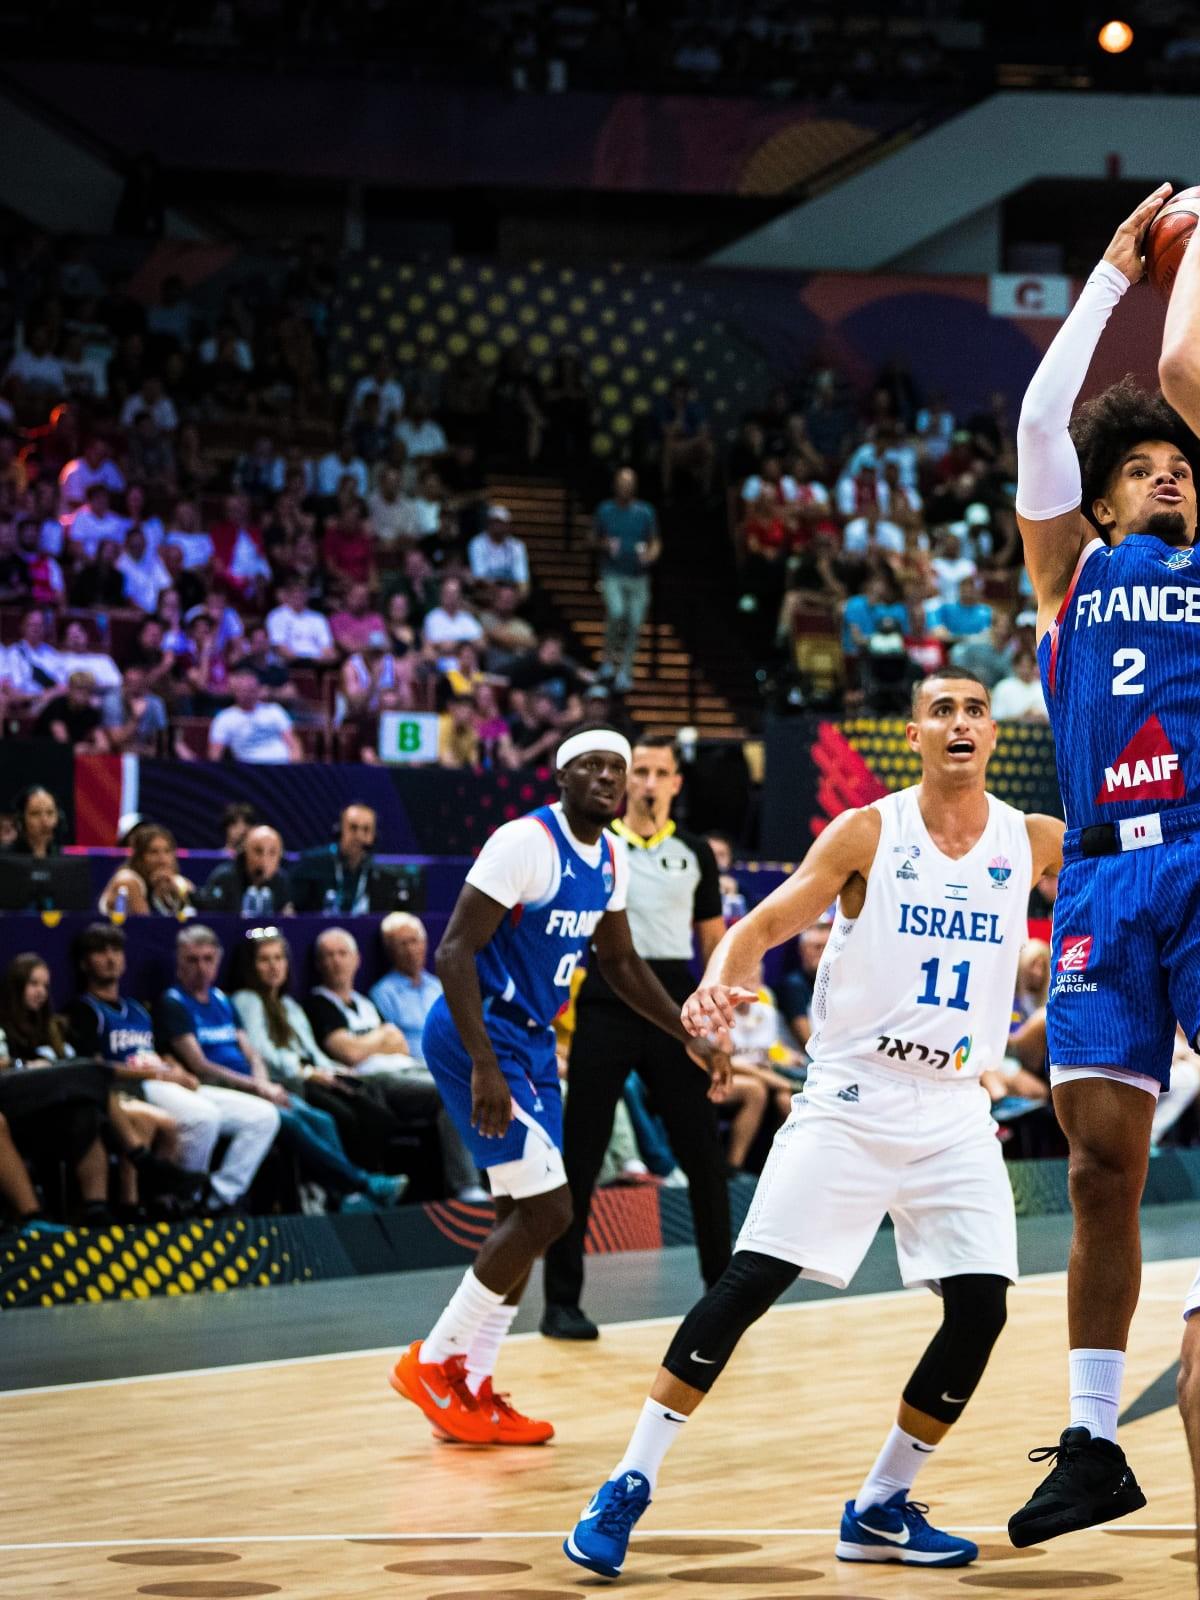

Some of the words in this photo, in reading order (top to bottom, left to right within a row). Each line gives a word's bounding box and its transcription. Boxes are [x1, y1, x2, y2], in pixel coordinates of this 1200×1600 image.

[1111, 647, 1147, 696] 2
[397, 722, 422, 753] B
[1104, 753, 1179, 793] MAIF
[897, 903, 1004, 944] ISRAEL
[916, 957, 971, 1012] 11
